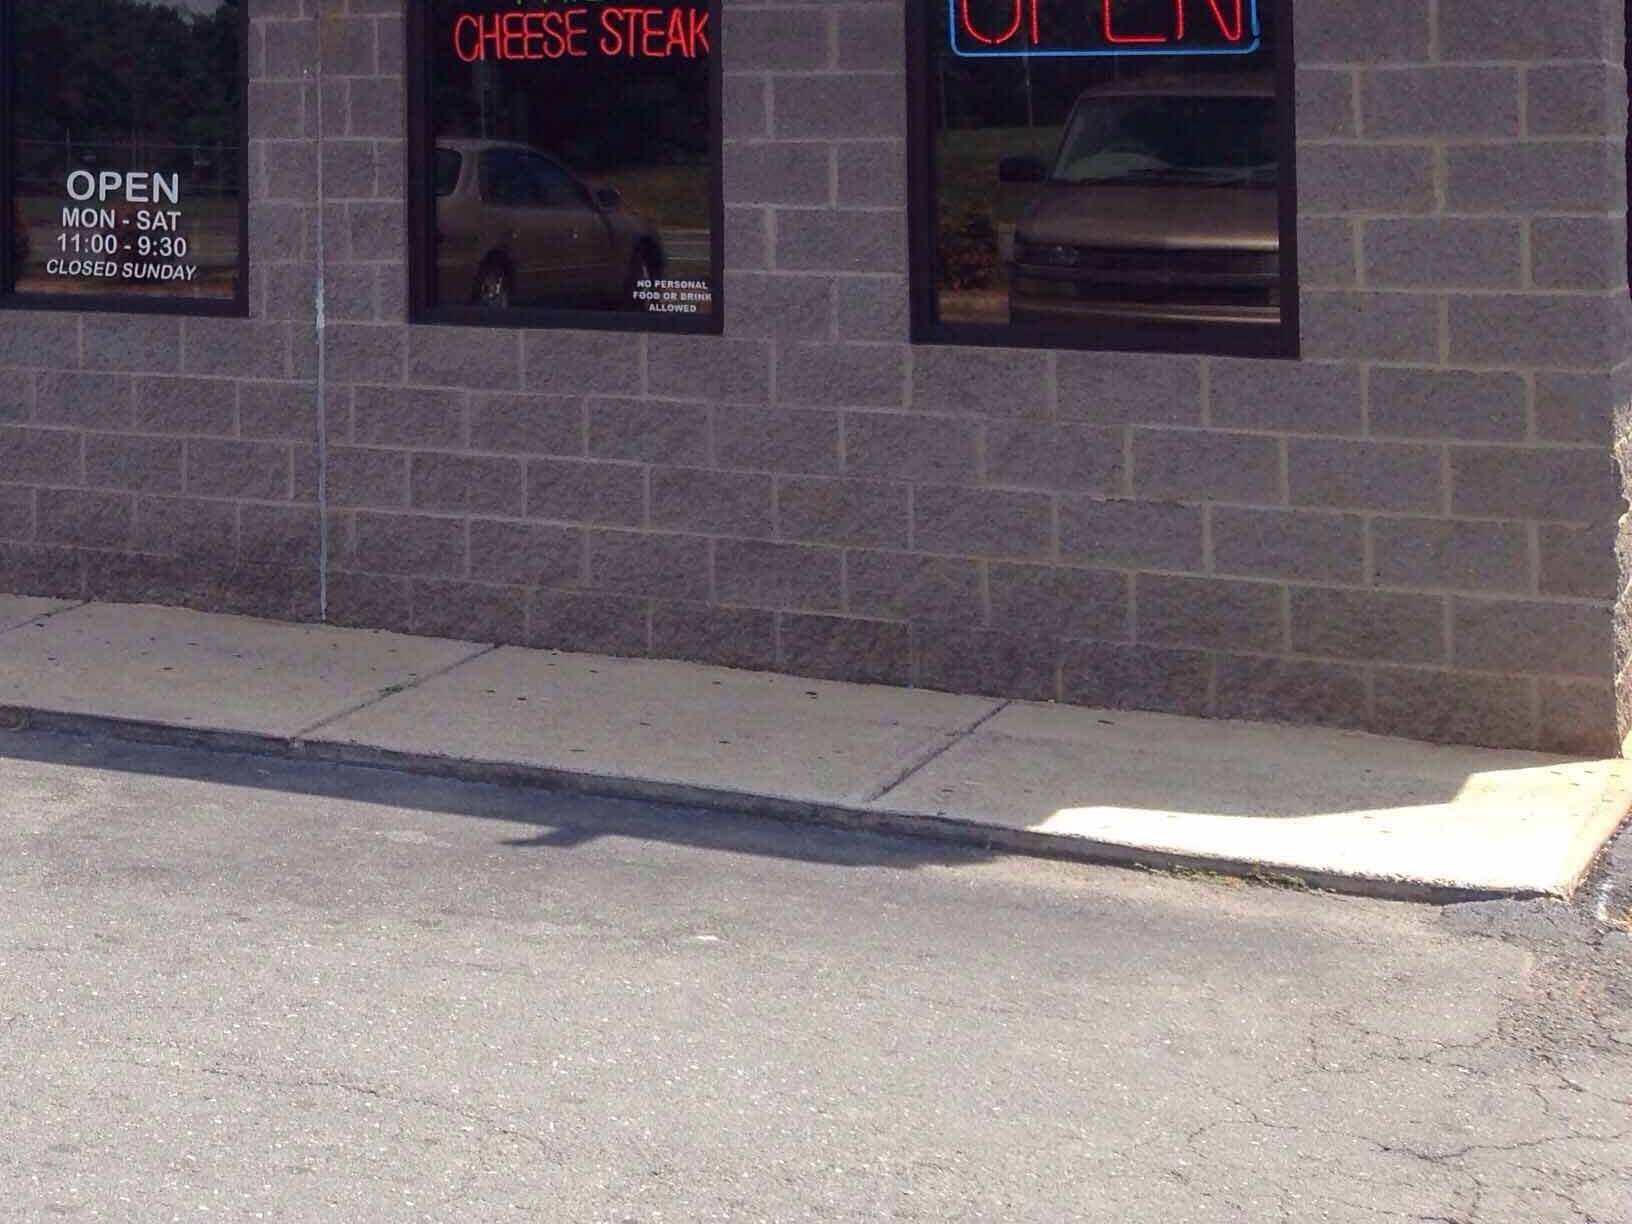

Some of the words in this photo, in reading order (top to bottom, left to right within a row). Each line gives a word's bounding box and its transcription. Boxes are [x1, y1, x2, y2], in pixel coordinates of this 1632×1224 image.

[454, 8, 588, 63] CHEESE
[600, 7, 710, 59] STEAK
[66, 170, 179, 204] OPEN
[62, 207, 116, 229] MON
[136, 210, 181, 231] SAT
[57, 233, 117, 255] 11:00
[137, 236, 186, 257] 9:30
[46, 259, 117, 277] CLOSED
[122, 262, 197, 280] SUNDAY
[637, 279, 652, 288] NO
[654, 279, 708, 289] PERSONAL
[633, 291, 660, 300] FOOD
[663, 292, 677, 301] OR
[649, 303, 697, 312] ALLOWED
